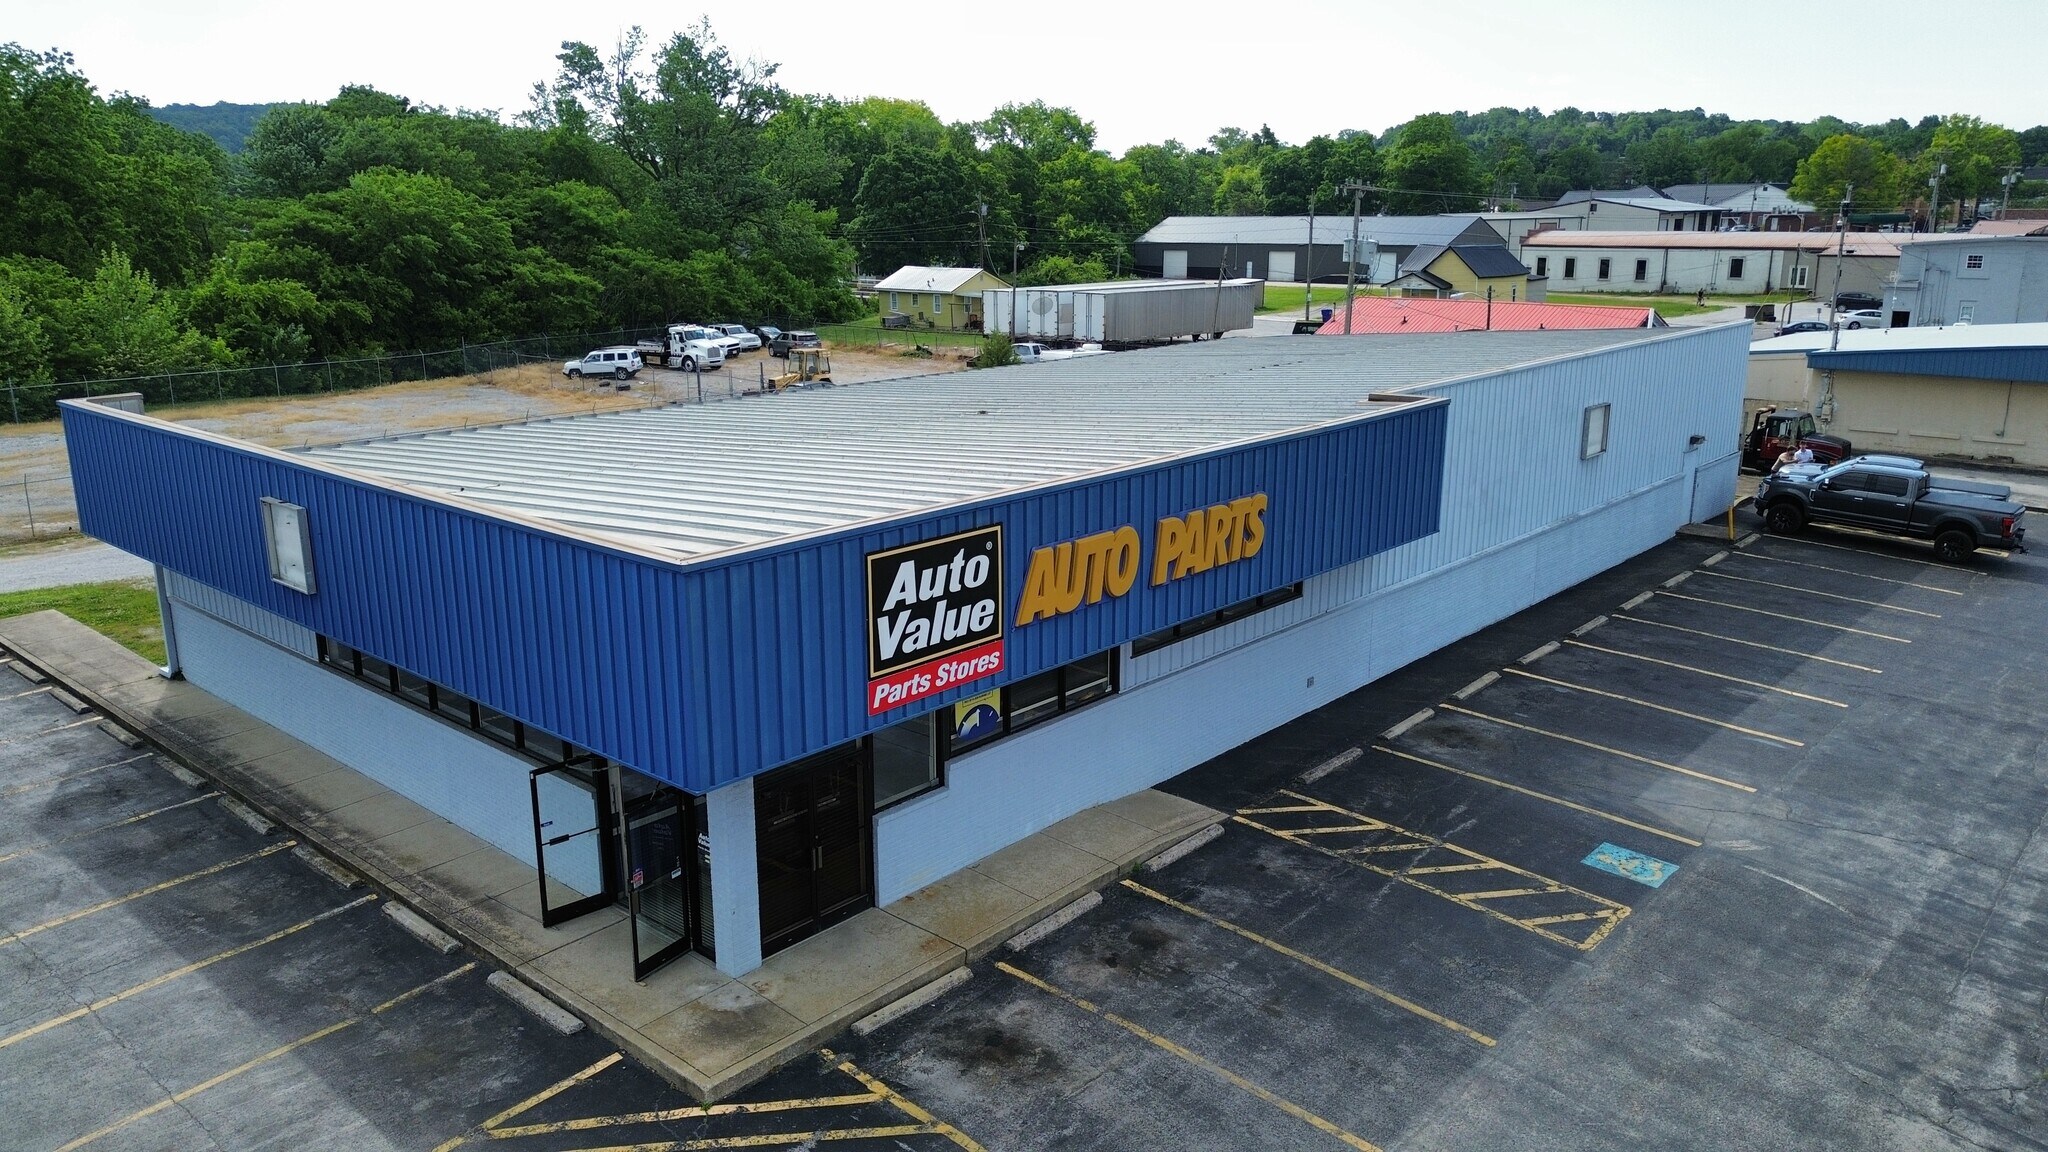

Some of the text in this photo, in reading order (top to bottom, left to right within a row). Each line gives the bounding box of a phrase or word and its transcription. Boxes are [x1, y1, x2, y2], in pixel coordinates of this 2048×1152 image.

[882, 548, 990, 612] Auto
[1015, 493, 1268, 628] AUTO PARTS
[877, 598, 996, 661] Value
[873, 673, 931, 709] Parts
[936, 651, 1000, 687] Stores
